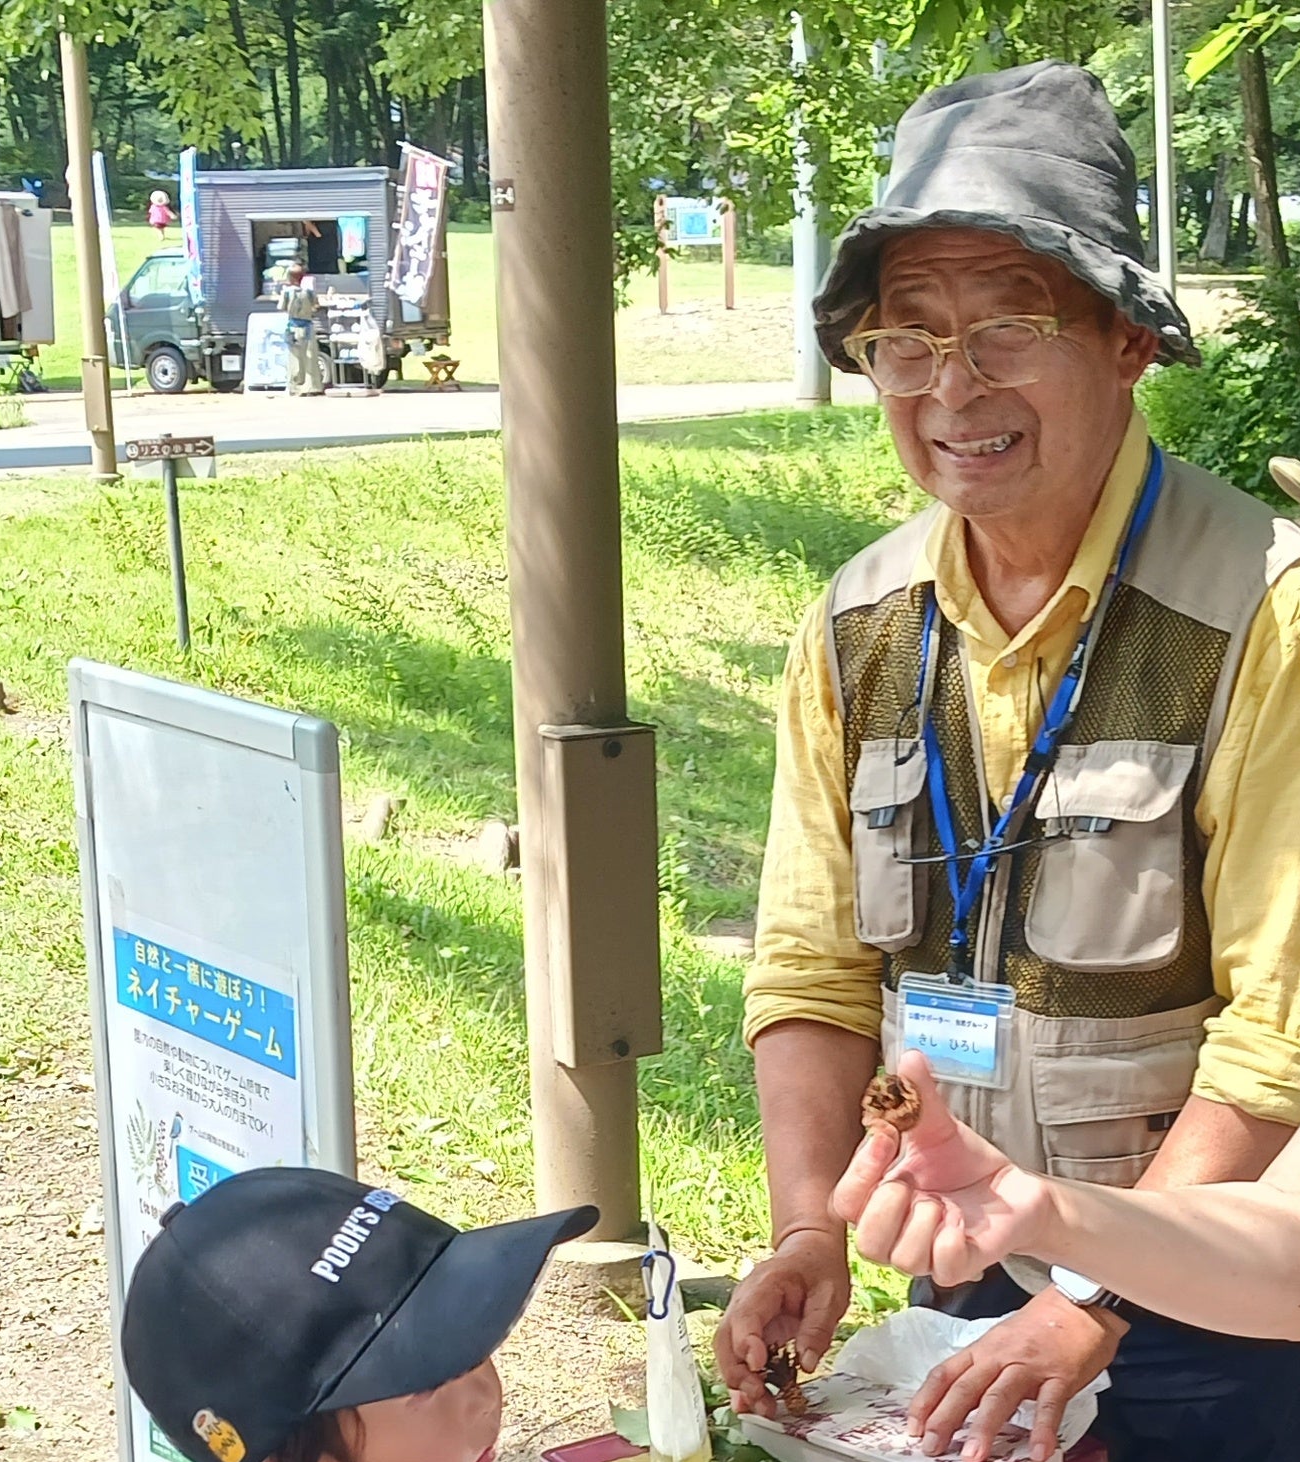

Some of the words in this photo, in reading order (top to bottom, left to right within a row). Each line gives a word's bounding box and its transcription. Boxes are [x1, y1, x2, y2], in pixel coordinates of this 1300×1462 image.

[134, 939, 268, 1013] 自然と一緒に遊ぼう！
[126, 970, 283, 1061] ネイチャーゲーム
[311, 1206, 380, 1283] POOH'S
